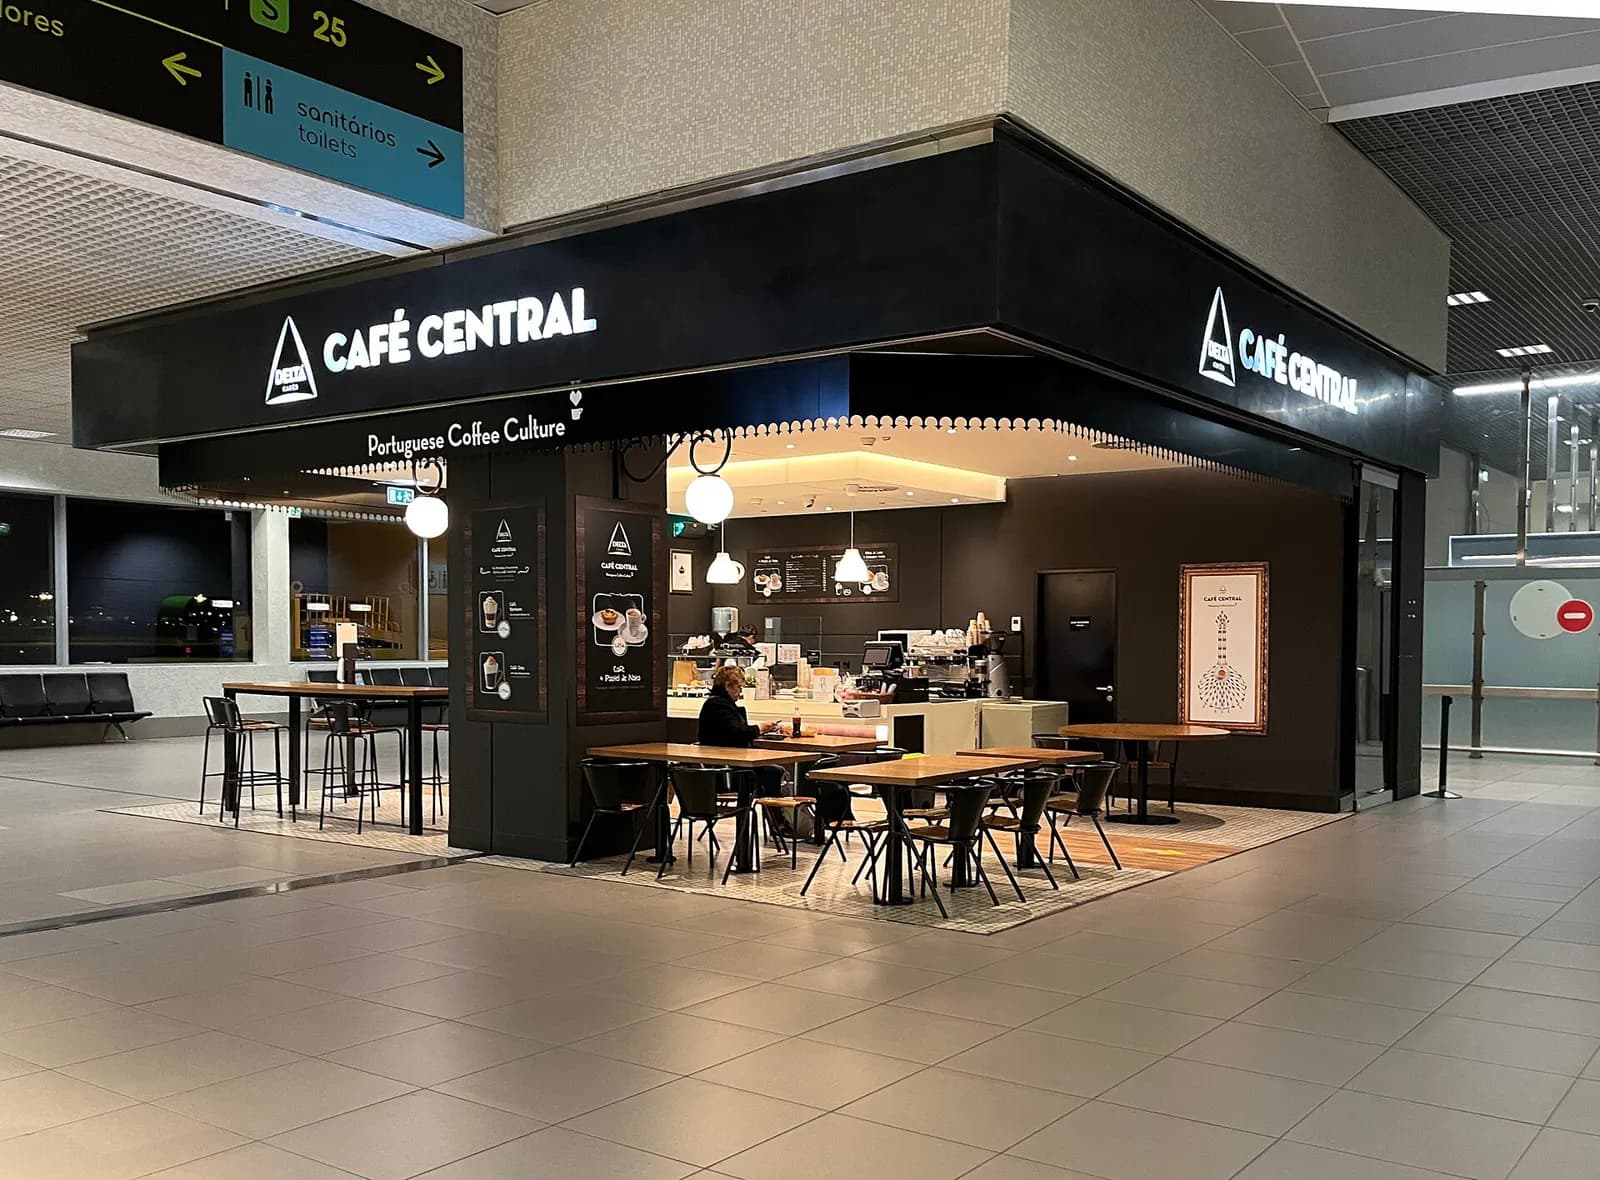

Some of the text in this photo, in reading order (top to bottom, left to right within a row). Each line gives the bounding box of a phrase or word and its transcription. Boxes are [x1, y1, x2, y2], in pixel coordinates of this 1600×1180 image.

[0, 0, 64, 37] ores
[313, 10, 347, 48] 25
[297, 102, 396, 148] sanitários
[298, 123, 357, 159] toilets
[323, 287, 597, 373] CAFÉ CENTRAL
[1239, 328, 1359, 416] CAFÉ CENTRAL
[368, 413, 566, 459] Portuguese Coffee Culture
